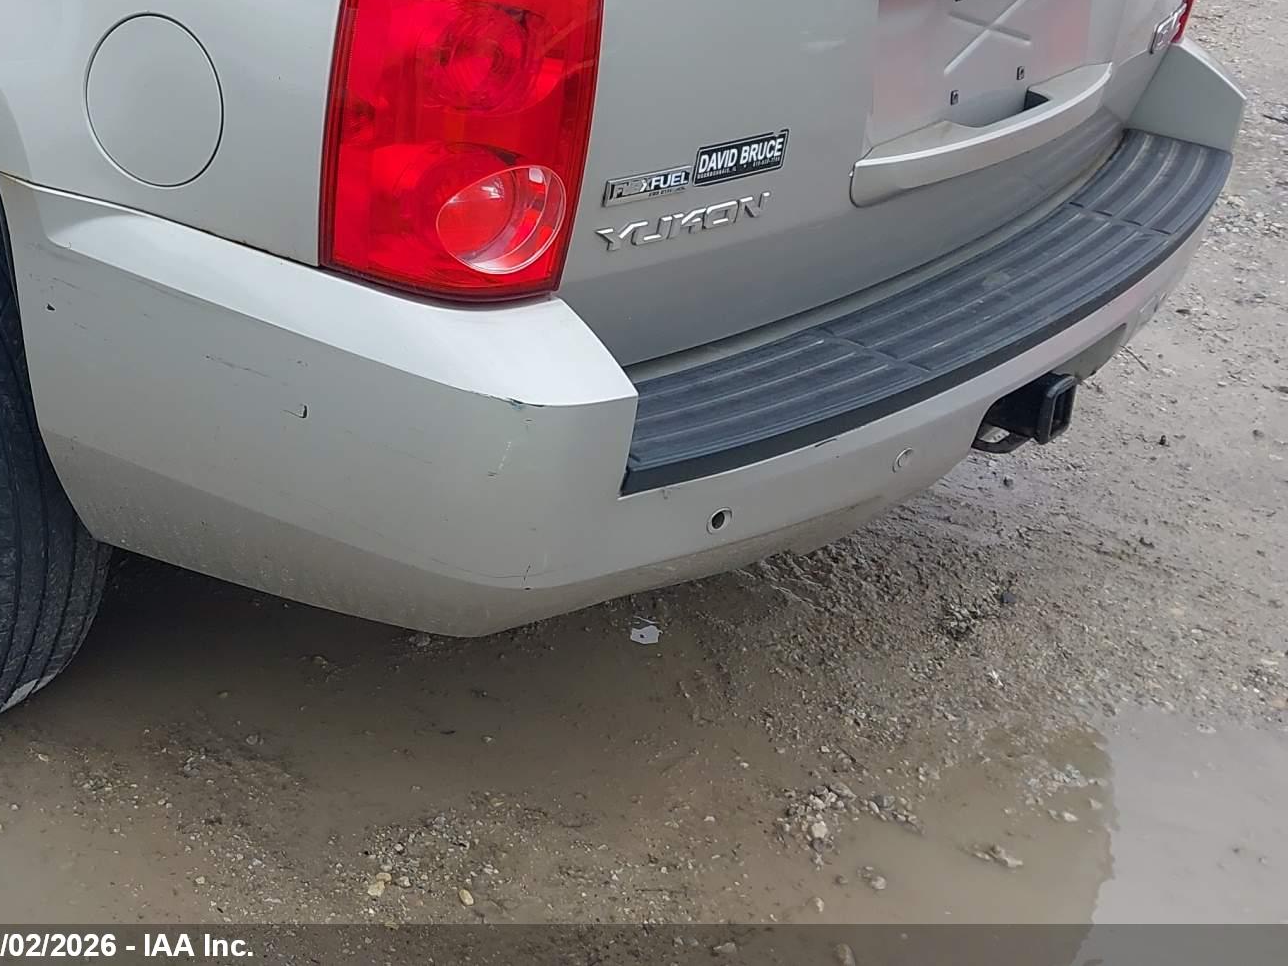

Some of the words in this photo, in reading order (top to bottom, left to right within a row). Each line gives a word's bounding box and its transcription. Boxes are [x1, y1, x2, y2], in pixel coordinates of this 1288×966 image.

[698, 148, 738, 173] DAVID
[739, 137, 784, 165] BRUCE
[595, 192, 771, 251] YUKON
